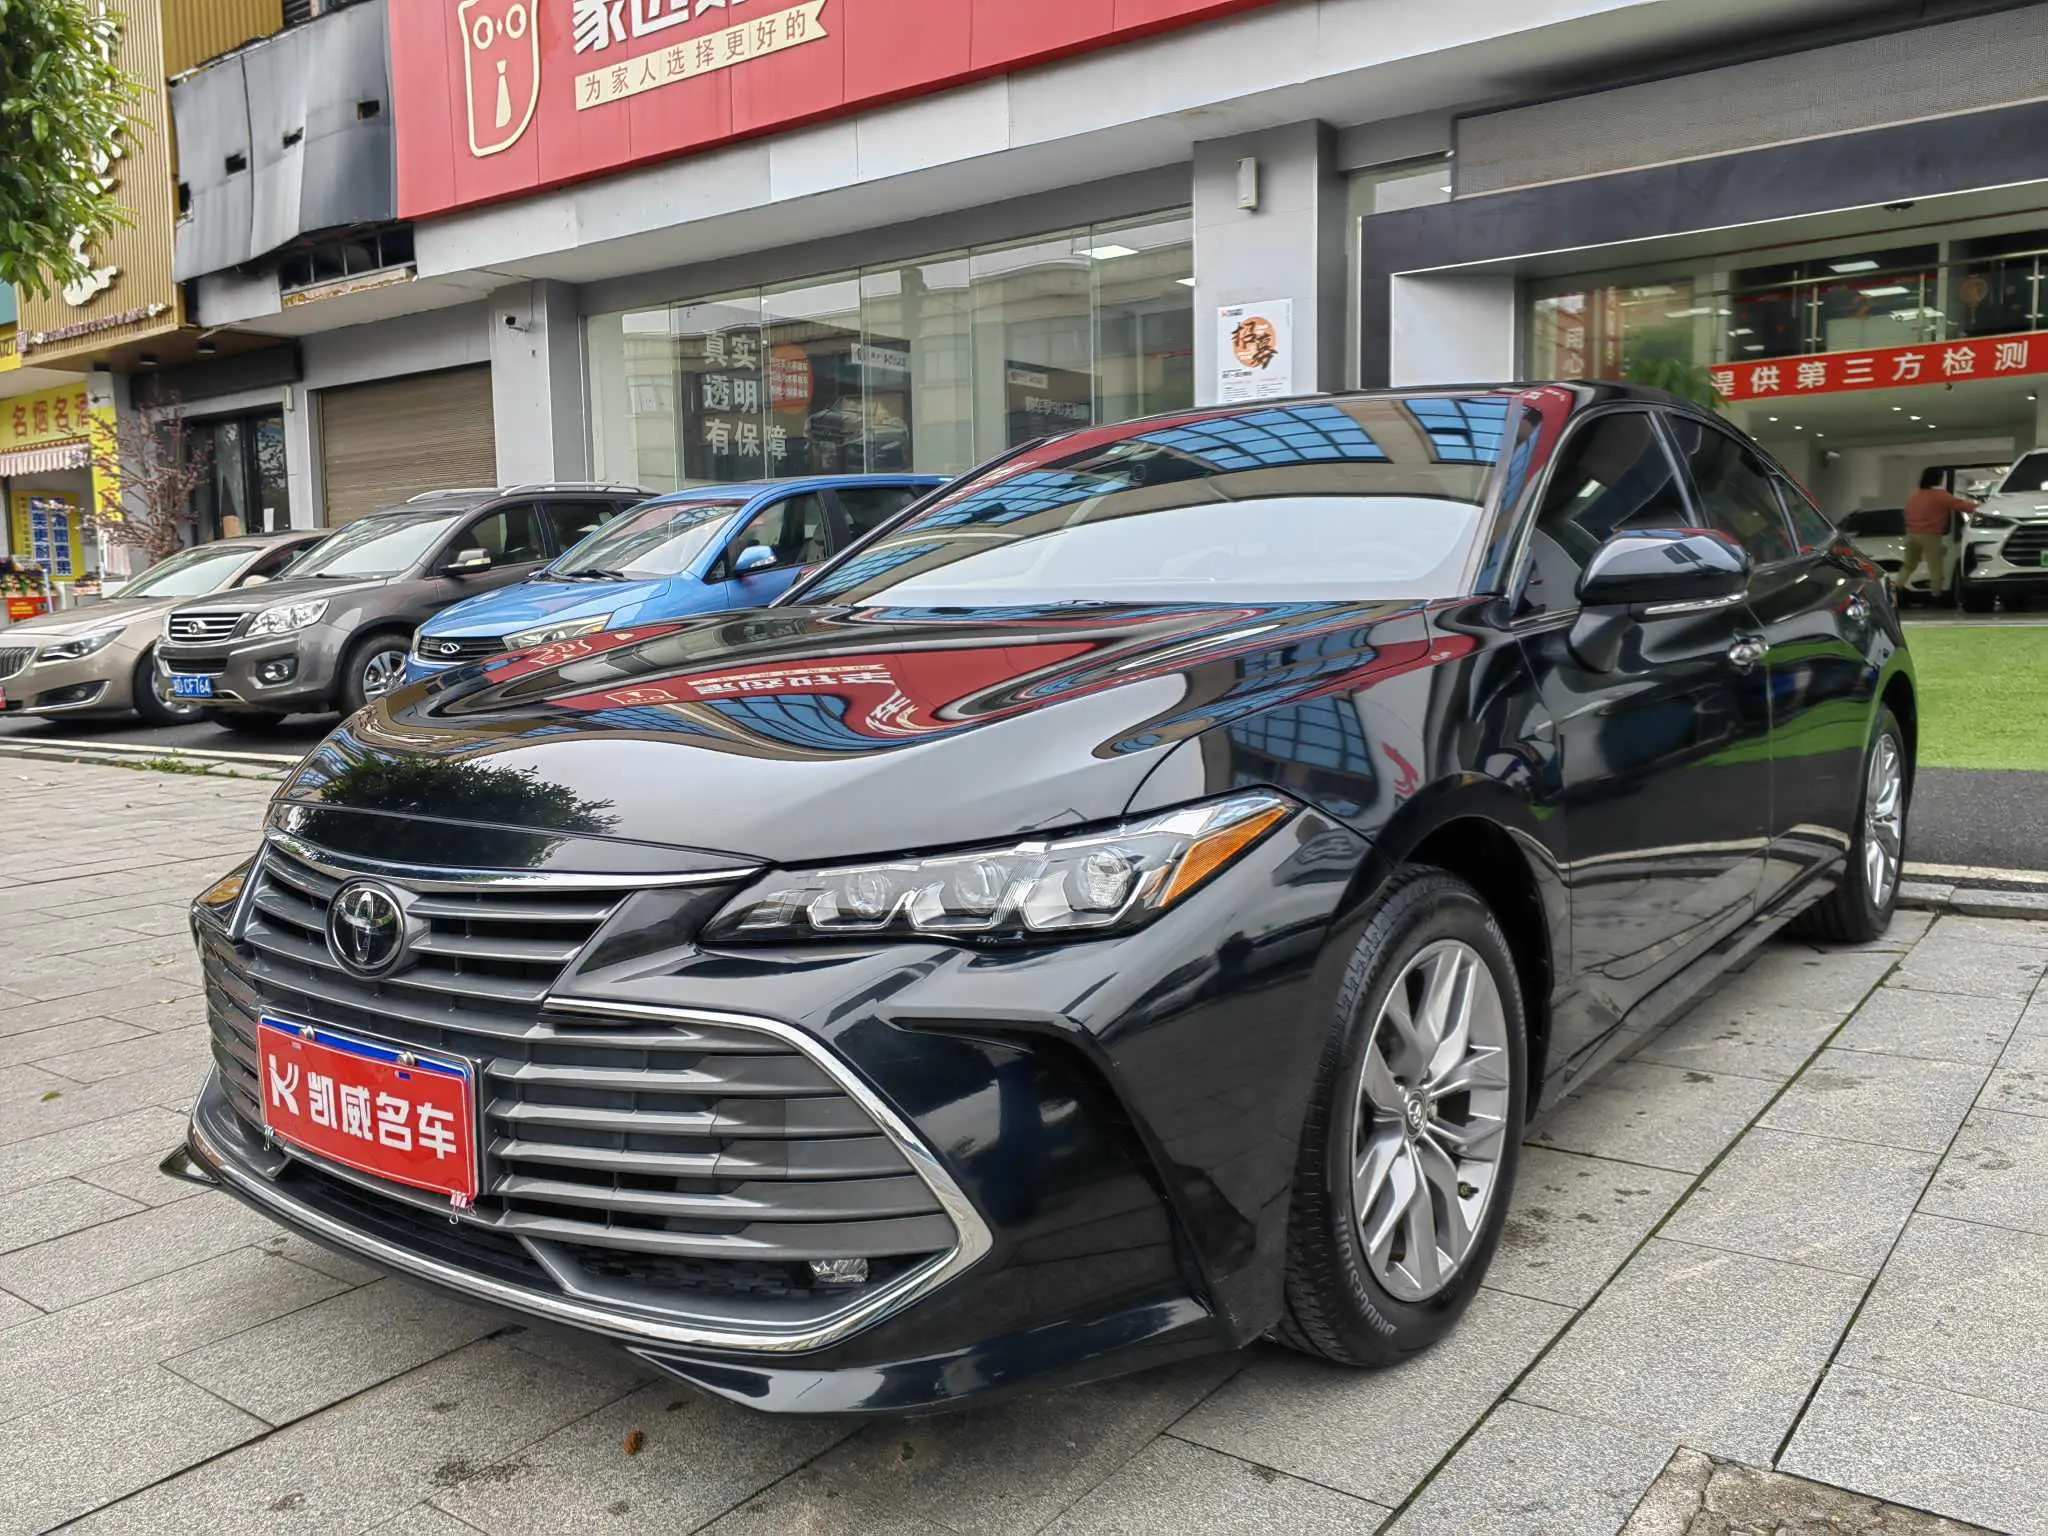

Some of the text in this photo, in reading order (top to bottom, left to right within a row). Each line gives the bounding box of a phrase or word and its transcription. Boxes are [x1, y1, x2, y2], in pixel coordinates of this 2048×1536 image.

[584, 11, 806, 102] 为家人选择更好的
[702, 332, 757, 371] 真实
[1711, 340, 2029, 397] 提供第三方检测
[703, 374, 758, 414] 透明
[704, 418, 788, 460] 有保障
[307, 1071, 457, 1160] 凯威名车
